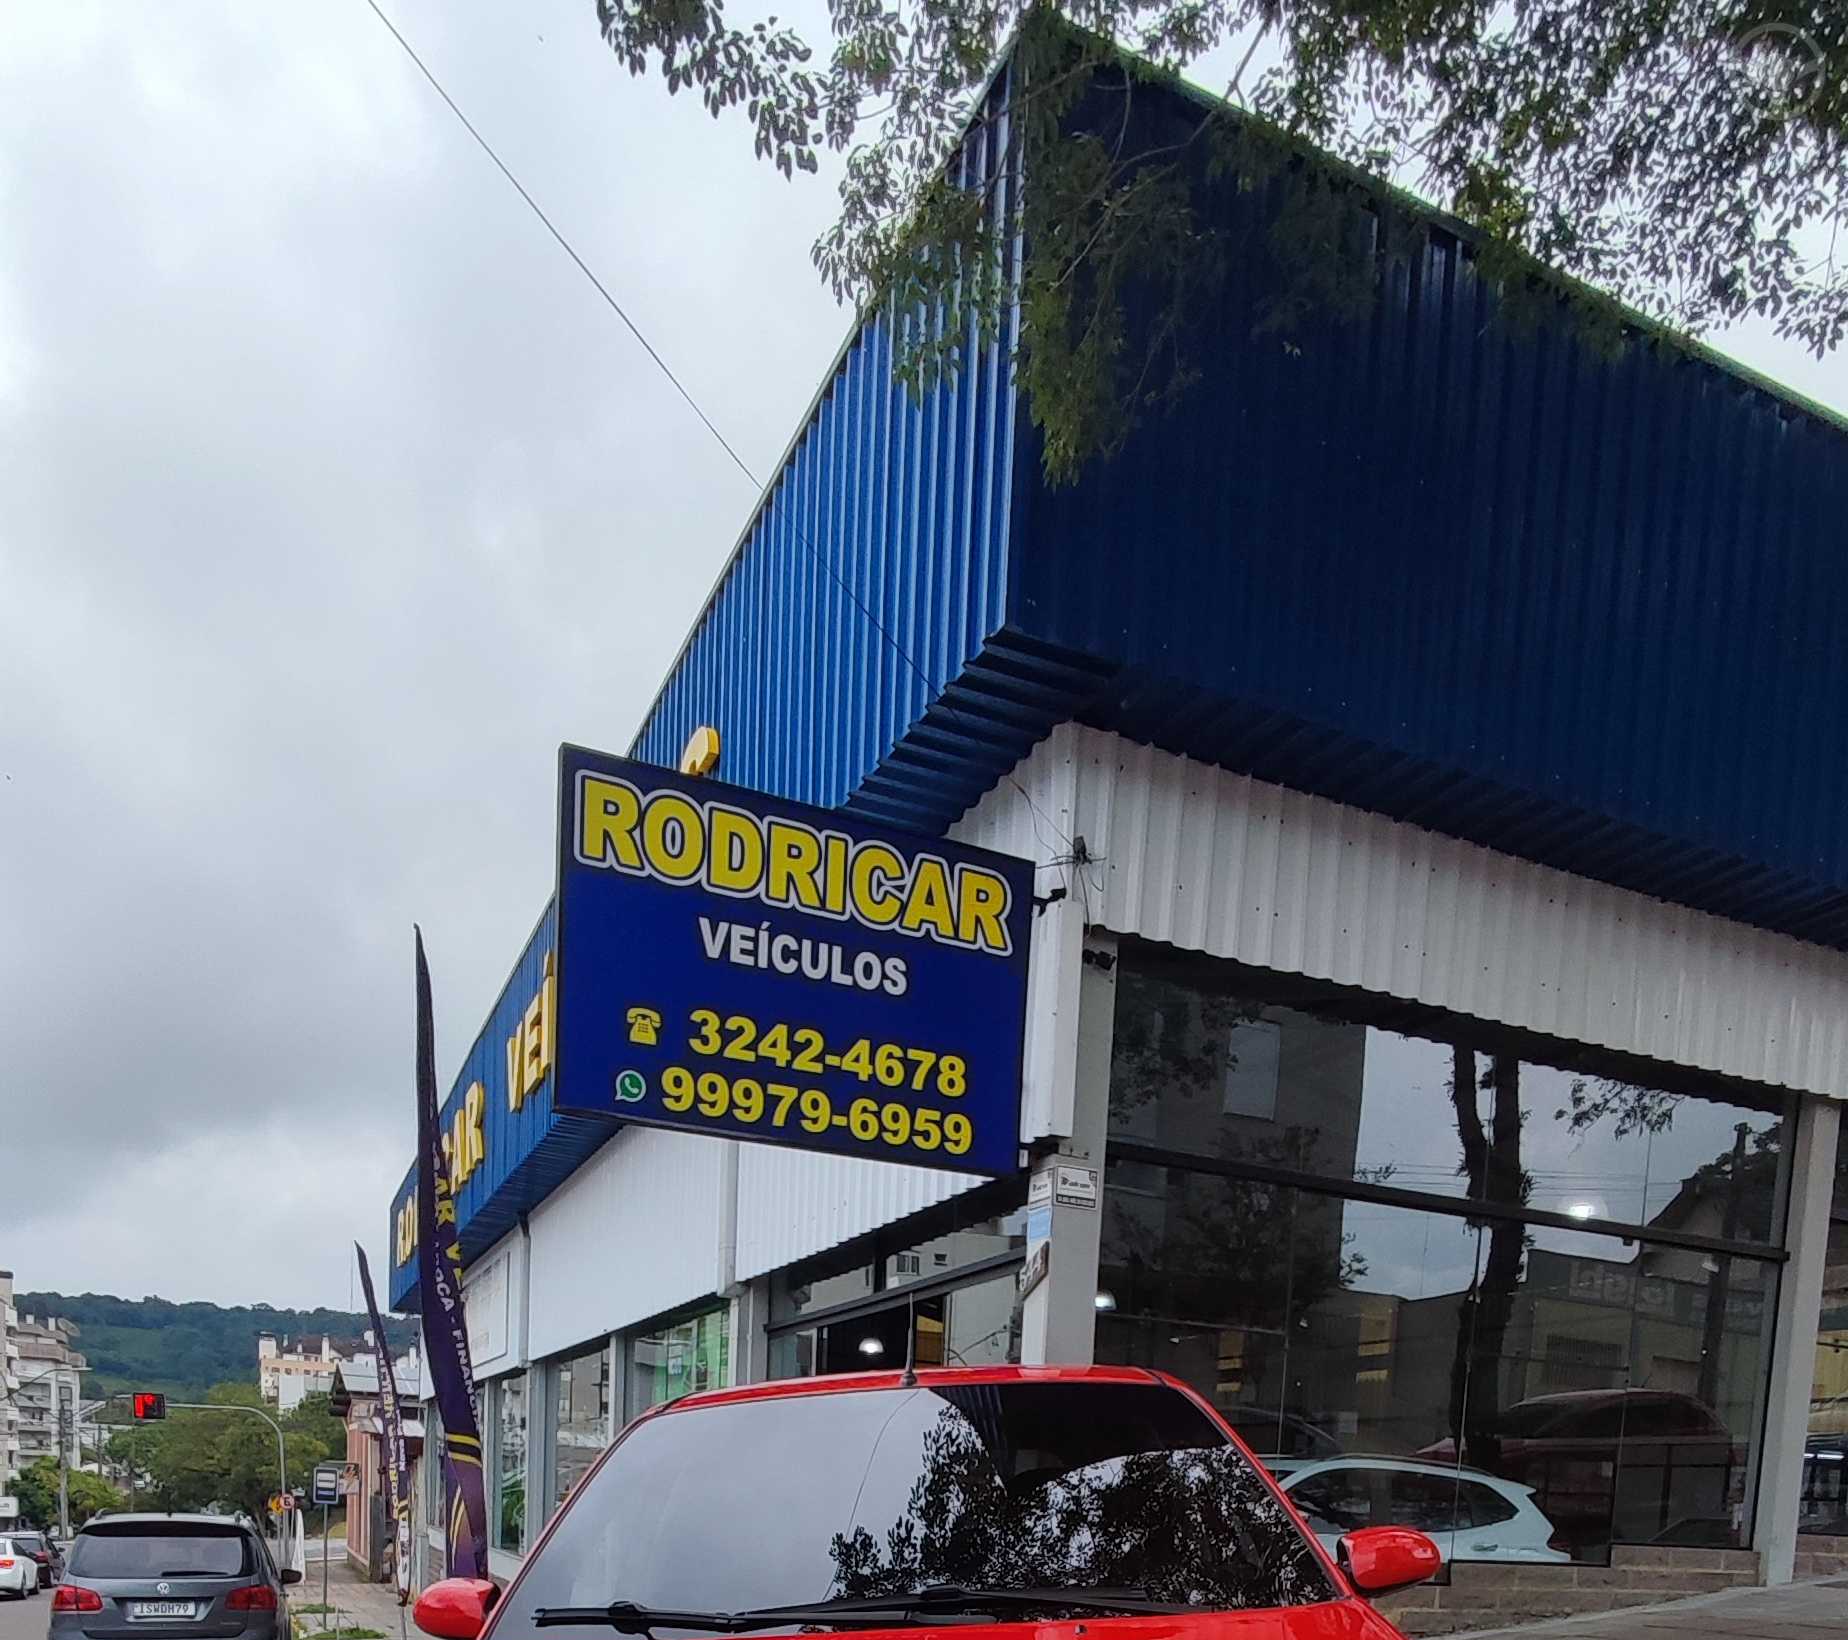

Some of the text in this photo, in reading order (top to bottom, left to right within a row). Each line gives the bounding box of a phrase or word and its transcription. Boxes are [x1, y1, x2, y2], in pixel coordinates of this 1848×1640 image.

[576, 770, 1012, 956] RODRICAR
[698, 917, 908, 995] VEÍCULOS
[689, 1009, 967, 1097] 3242-4678
[661, 1066, 972, 1155] 99979-6959
